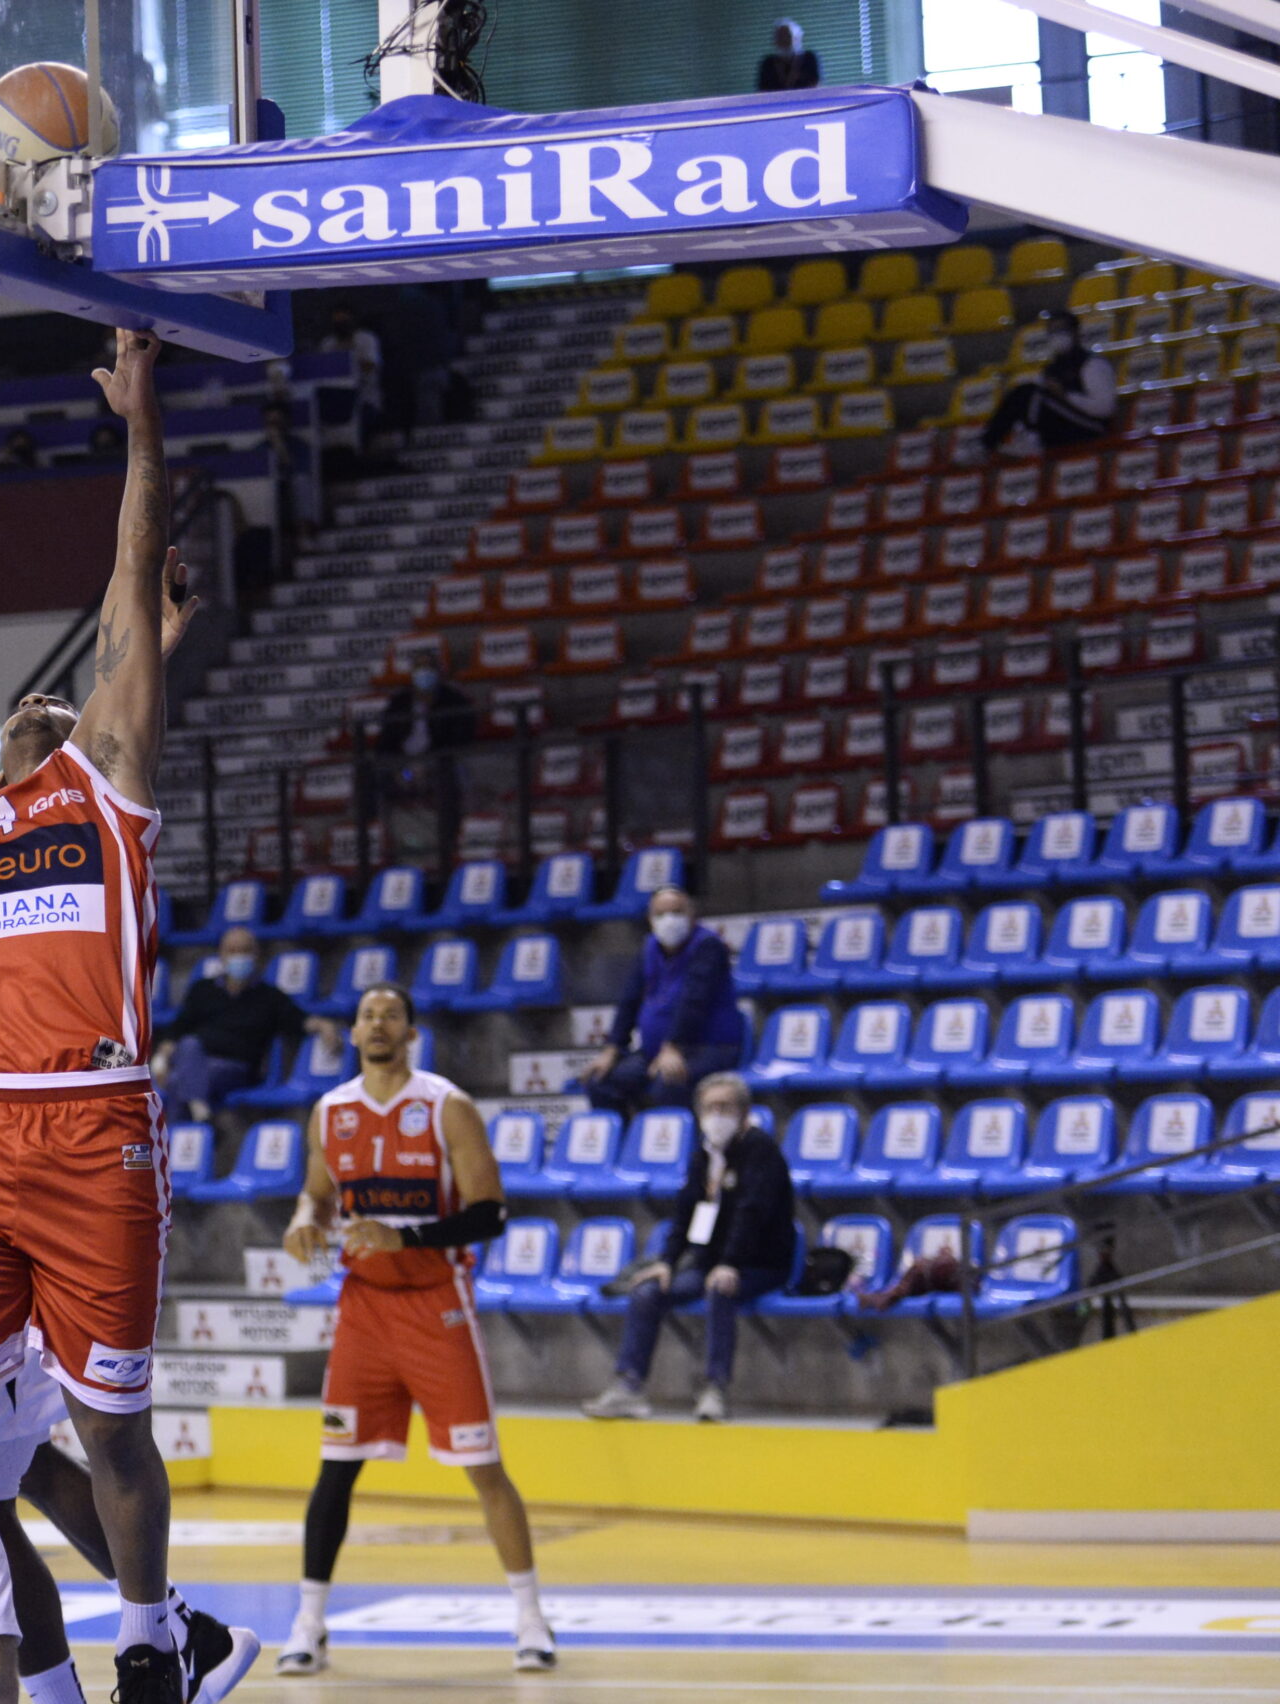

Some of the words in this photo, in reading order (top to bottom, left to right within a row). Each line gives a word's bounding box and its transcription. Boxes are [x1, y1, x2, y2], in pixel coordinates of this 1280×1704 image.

[251, 121, 857, 249] saniRad
[27, 788, 86, 819] IGNIS
[372, 1136, 385, 1173] 1
